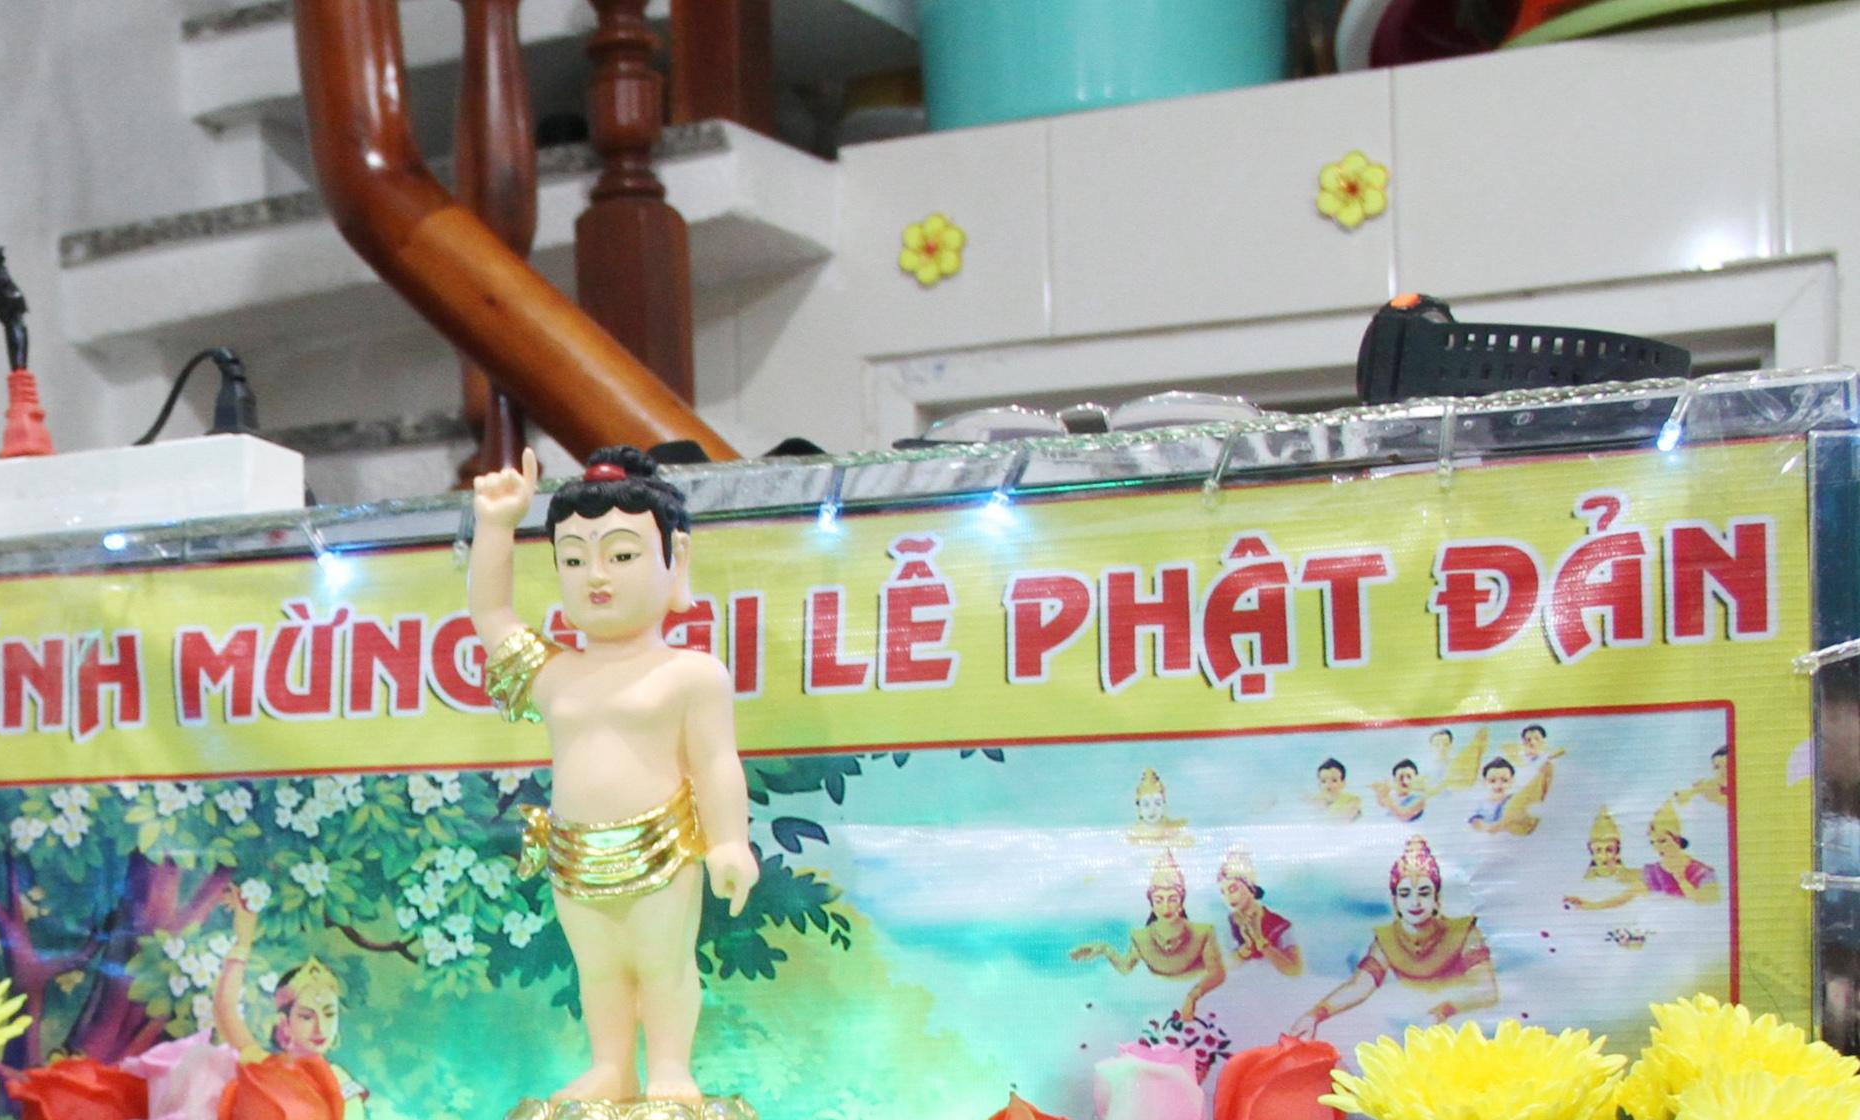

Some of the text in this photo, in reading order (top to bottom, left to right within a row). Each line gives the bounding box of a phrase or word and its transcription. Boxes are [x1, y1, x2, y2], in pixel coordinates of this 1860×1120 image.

[175, 599, 492, 724] MỪNG
[804, 533, 955, 695] LỄ
[1004, 535, 1392, 700] PHẬT
[1432, 490, 1779, 664] ĐẢN
